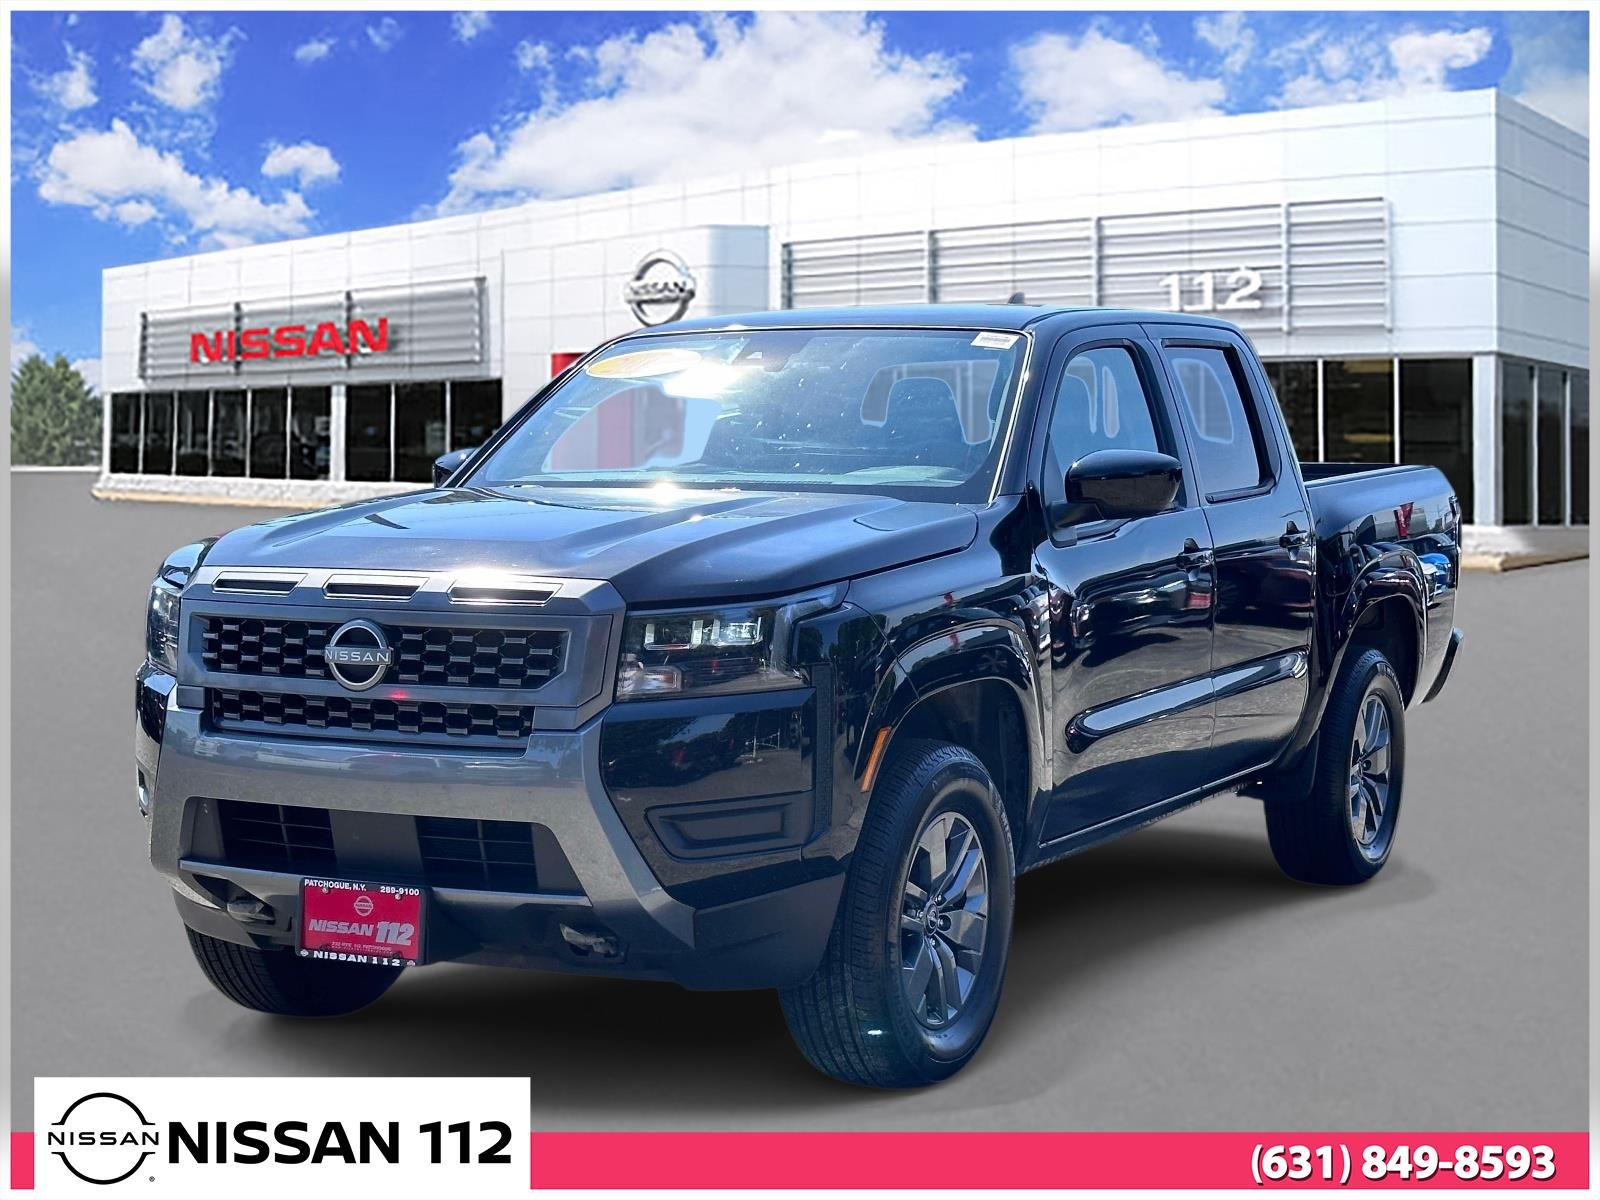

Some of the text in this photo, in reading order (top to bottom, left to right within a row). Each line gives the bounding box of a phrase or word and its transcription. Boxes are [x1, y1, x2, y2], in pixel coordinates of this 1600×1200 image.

[1159, 269, 1262, 312] 112
[190, 317, 388, 363] NISSAN
[325, 649, 389, 662] NISSAN
[304, 879, 420, 896] PATCHOGUE, N.Y. 289-9100
[308, 919, 374, 937] NISSAN
[375, 921, 415, 946] 112
[313, 950, 368, 964] NISSAN
